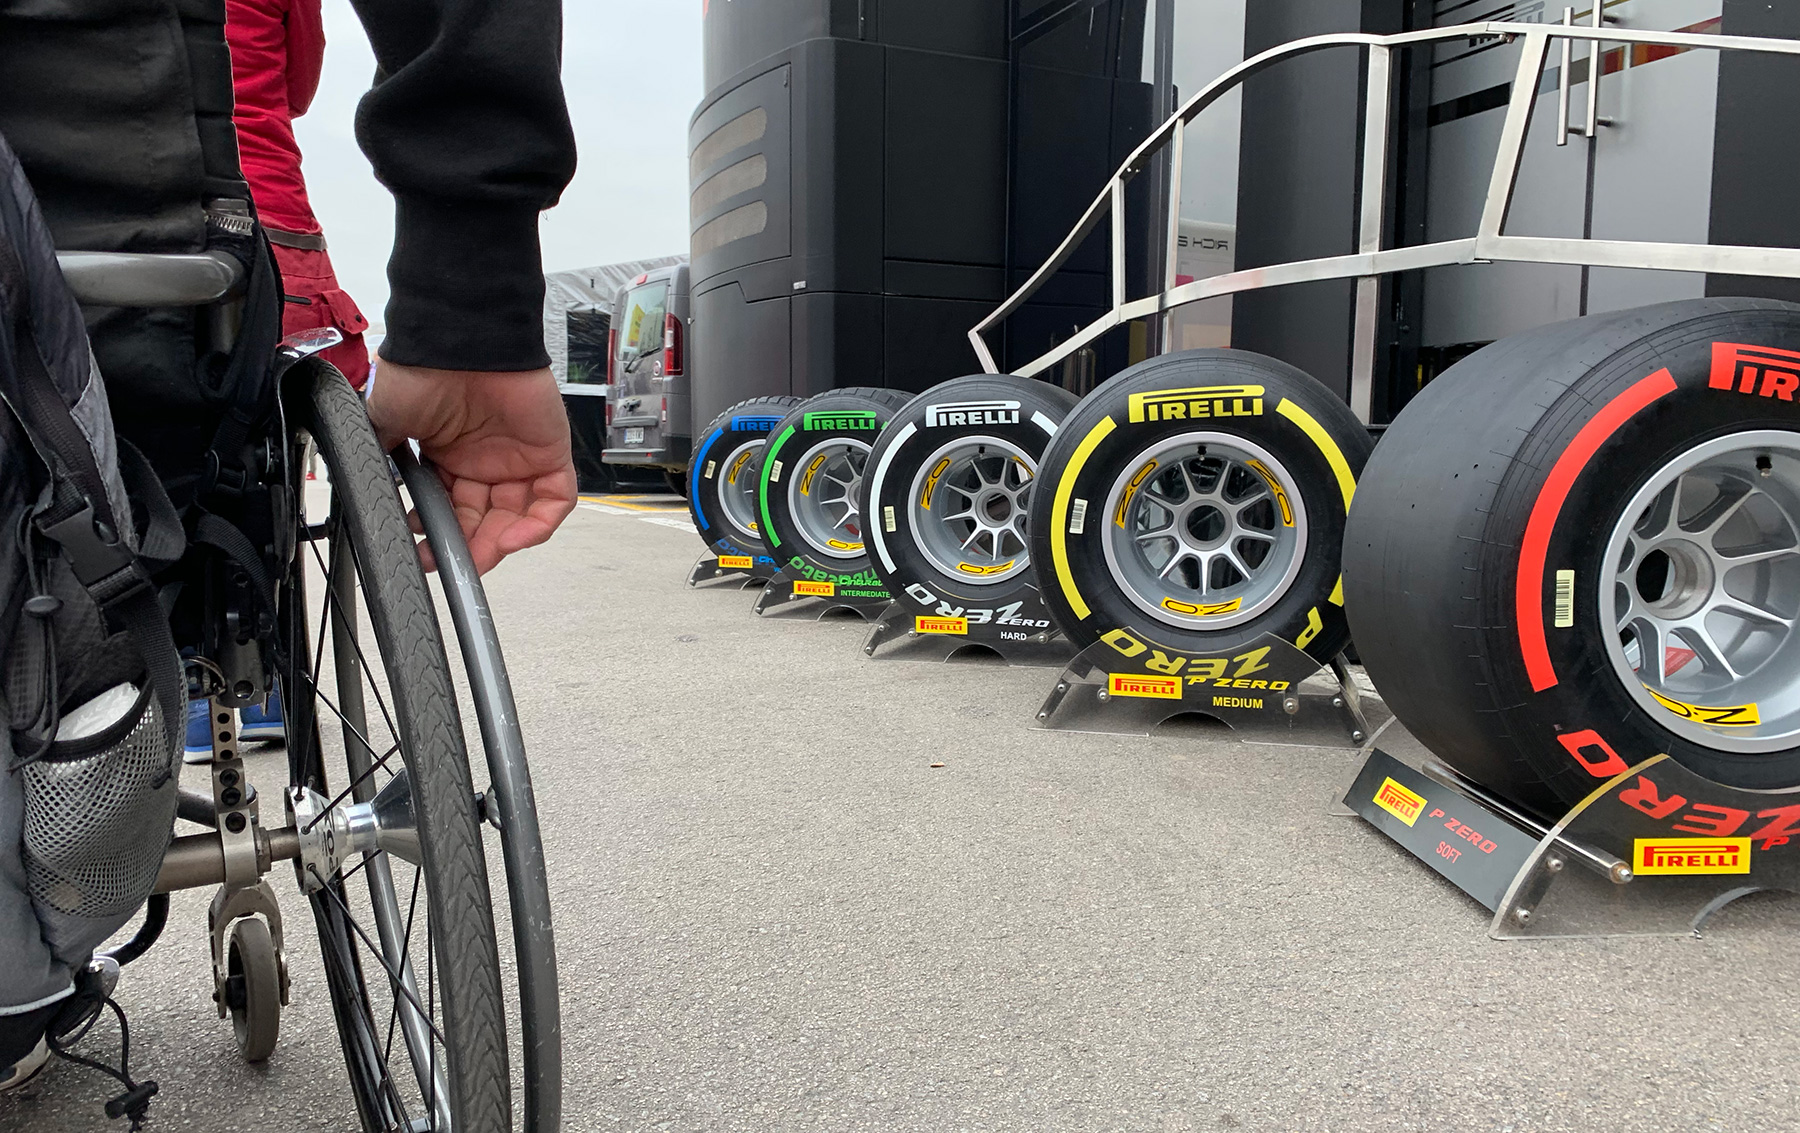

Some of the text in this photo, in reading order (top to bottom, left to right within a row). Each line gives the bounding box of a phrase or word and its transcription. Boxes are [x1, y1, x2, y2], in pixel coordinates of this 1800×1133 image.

[1128, 384, 1266, 424] PIRELLI
[804, 410, 877, 431] PIRELLI
[925, 400, 1022, 428] PIRELLI
[797, 583, 831, 594] PIRELLI
[840, 588, 891, 599] INTERMEDIATE
[920, 619, 964, 632] PIRELLI
[995, 617, 1051, 629] ZERO
[1000, 631, 1028, 641] HARD
[1100, 628, 1272, 681] ZERO
[1115, 677, 1176, 695] PIRELLI
[1187, 676, 1291, 692] P ZERO
[1212, 696, 1264, 710] MEDIUM
[1379, 783, 1421, 820] PIRELLI
[1428, 807, 1498, 855] P ZERO
[1435, 840, 1463, 864] SOFT
[1642, 844, 1740, 868] PIRELLI
